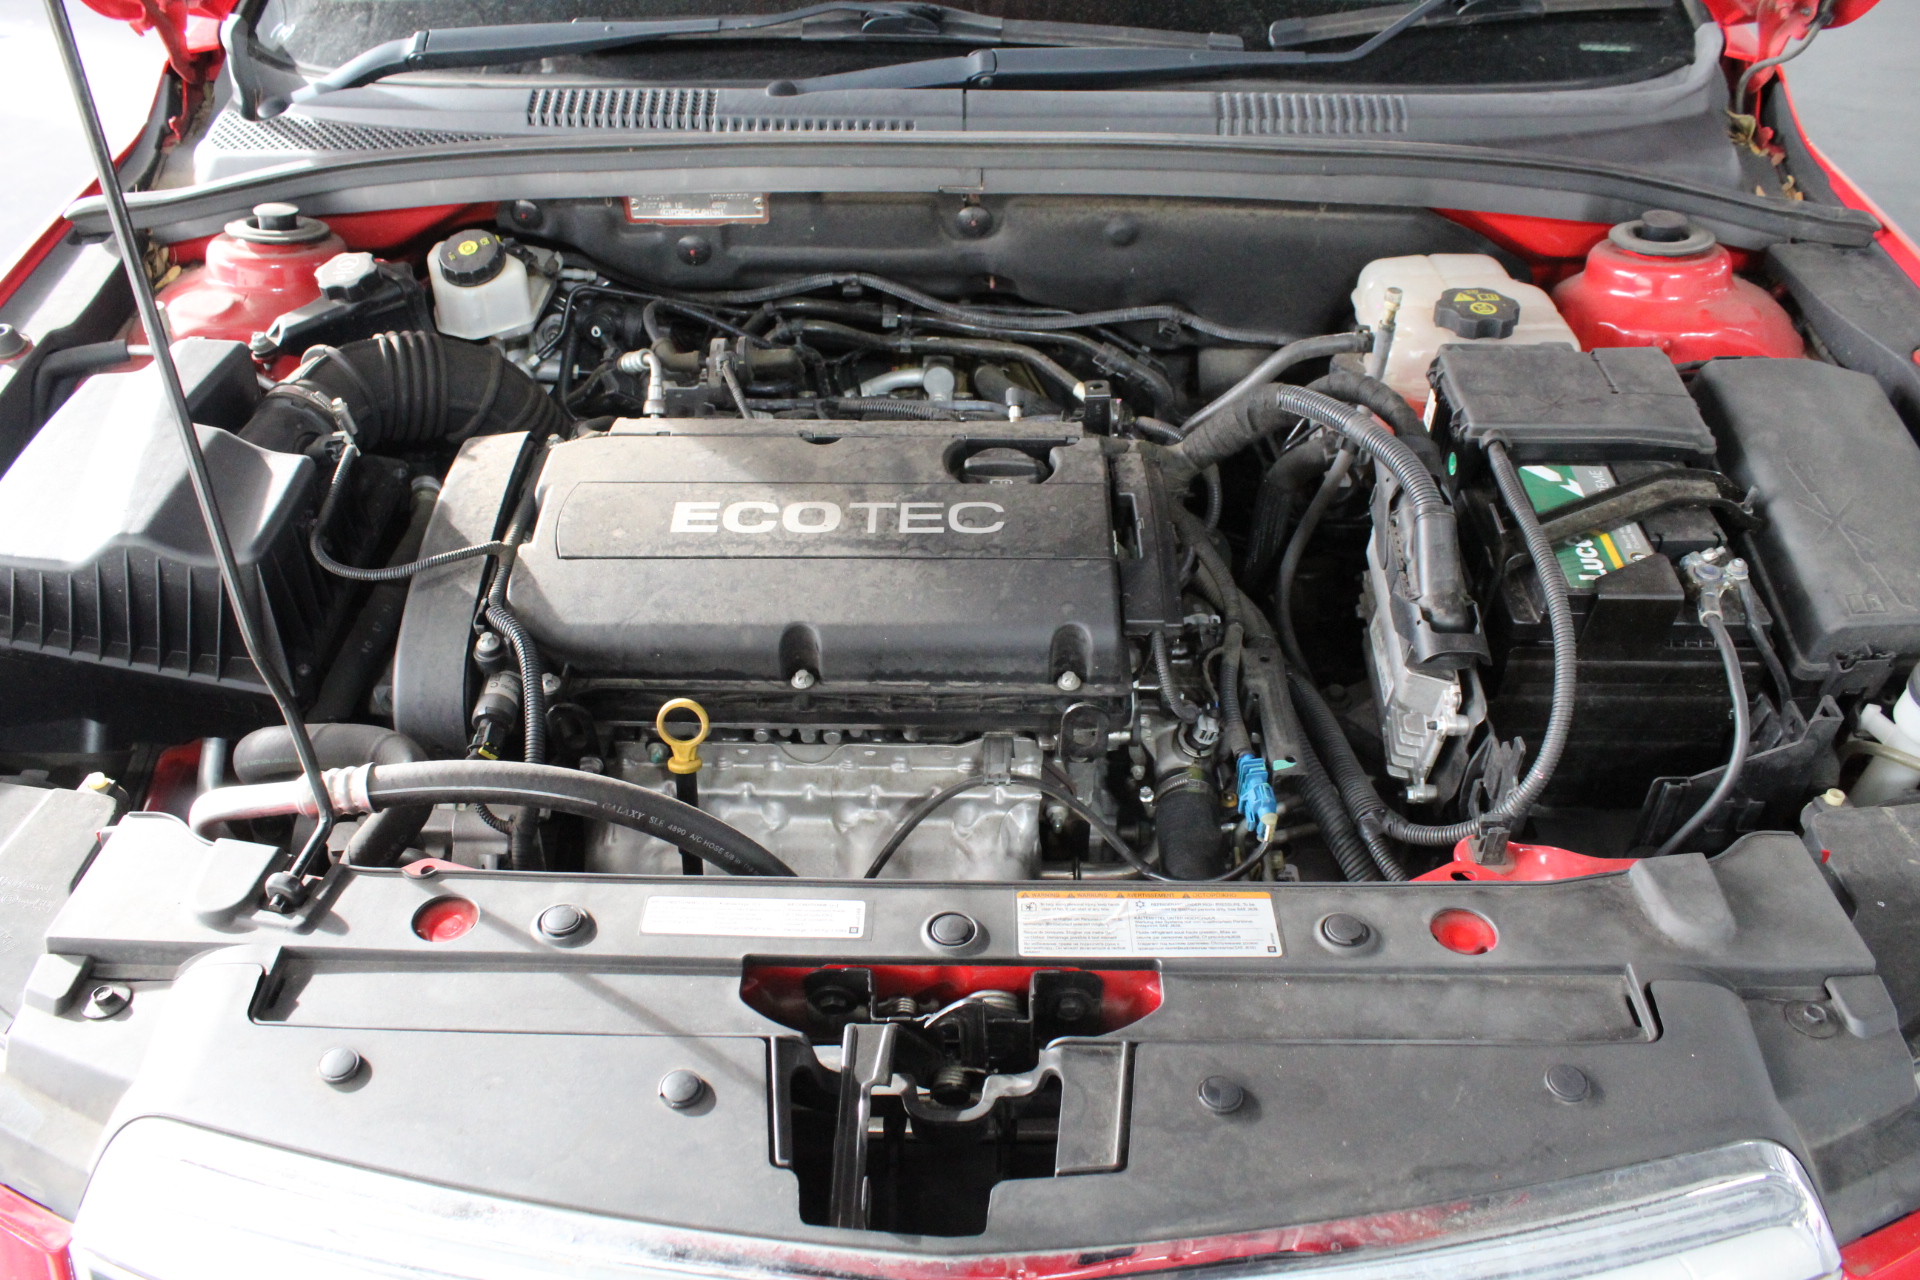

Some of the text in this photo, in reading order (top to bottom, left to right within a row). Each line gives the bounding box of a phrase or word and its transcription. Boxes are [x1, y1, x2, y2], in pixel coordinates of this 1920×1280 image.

[670, 501, 1005, 533] ECOTEC
[602, 802, 645, 820] GALAXY
[667, 824, 686, 835] 4890
[689, 834, 703, 843] A/C
[703, 839, 724, 854] HOSE
